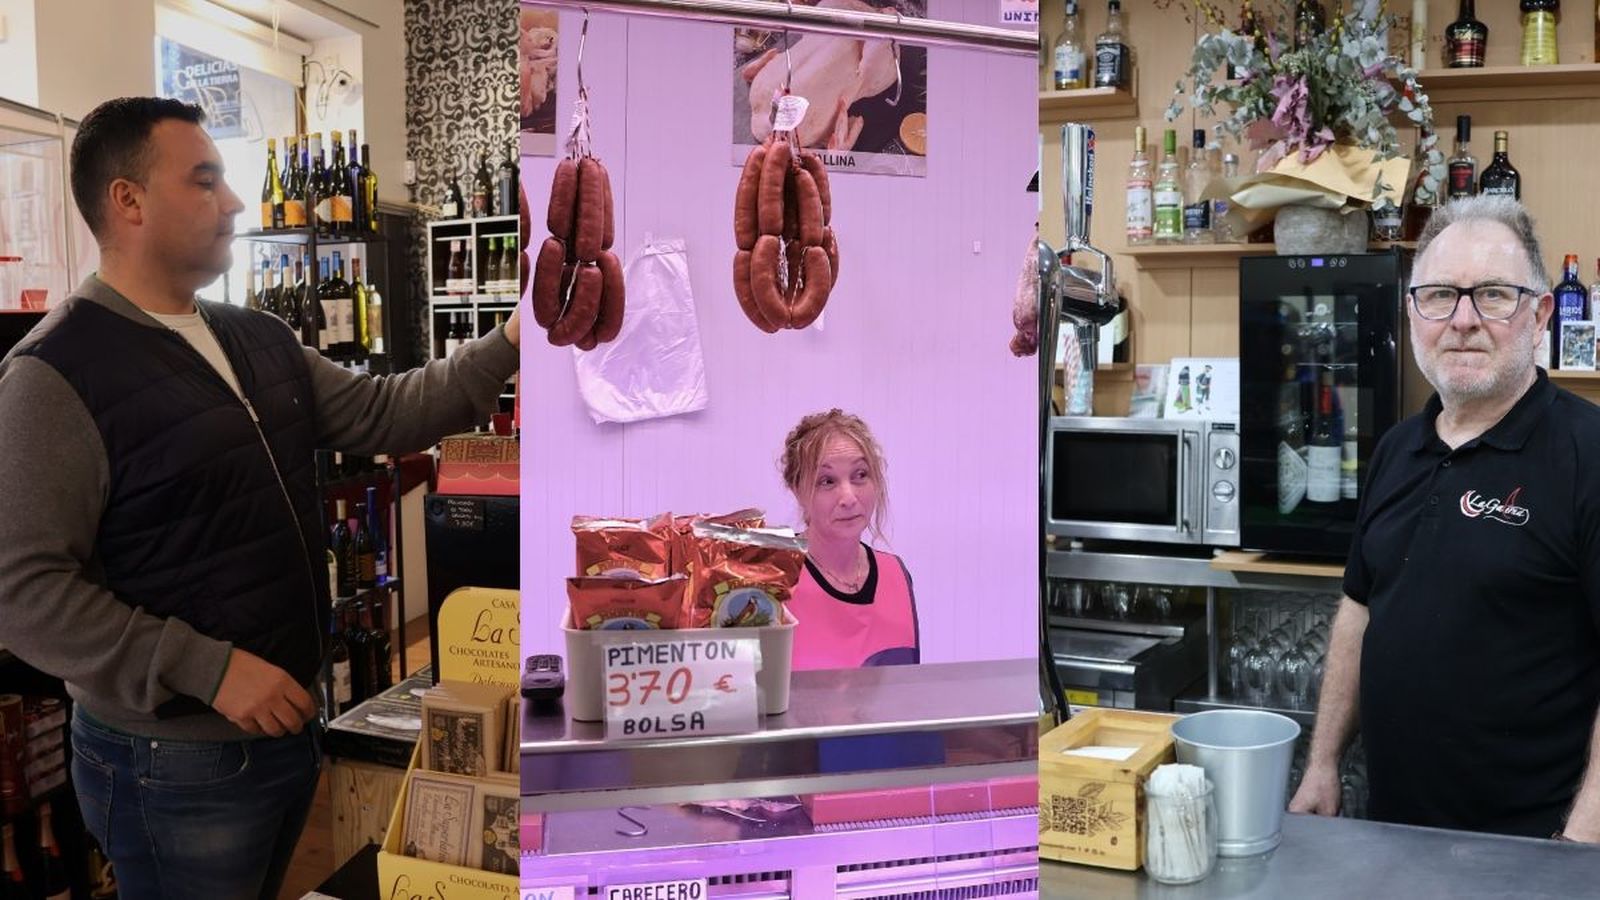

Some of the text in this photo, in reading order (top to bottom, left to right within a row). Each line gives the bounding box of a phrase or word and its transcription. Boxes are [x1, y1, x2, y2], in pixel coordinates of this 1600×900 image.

[492, 599, 516, 609] CASA
[472, 609, 503, 643] La
[449, 645, 509, 659] CHOCOLATES
[608, 641, 737, 667] PIMENTON
[713, 674, 736, 694] €
[623, 711, 705, 735] BOLSA
[449, 875, 511, 893] CHOCOLATES
